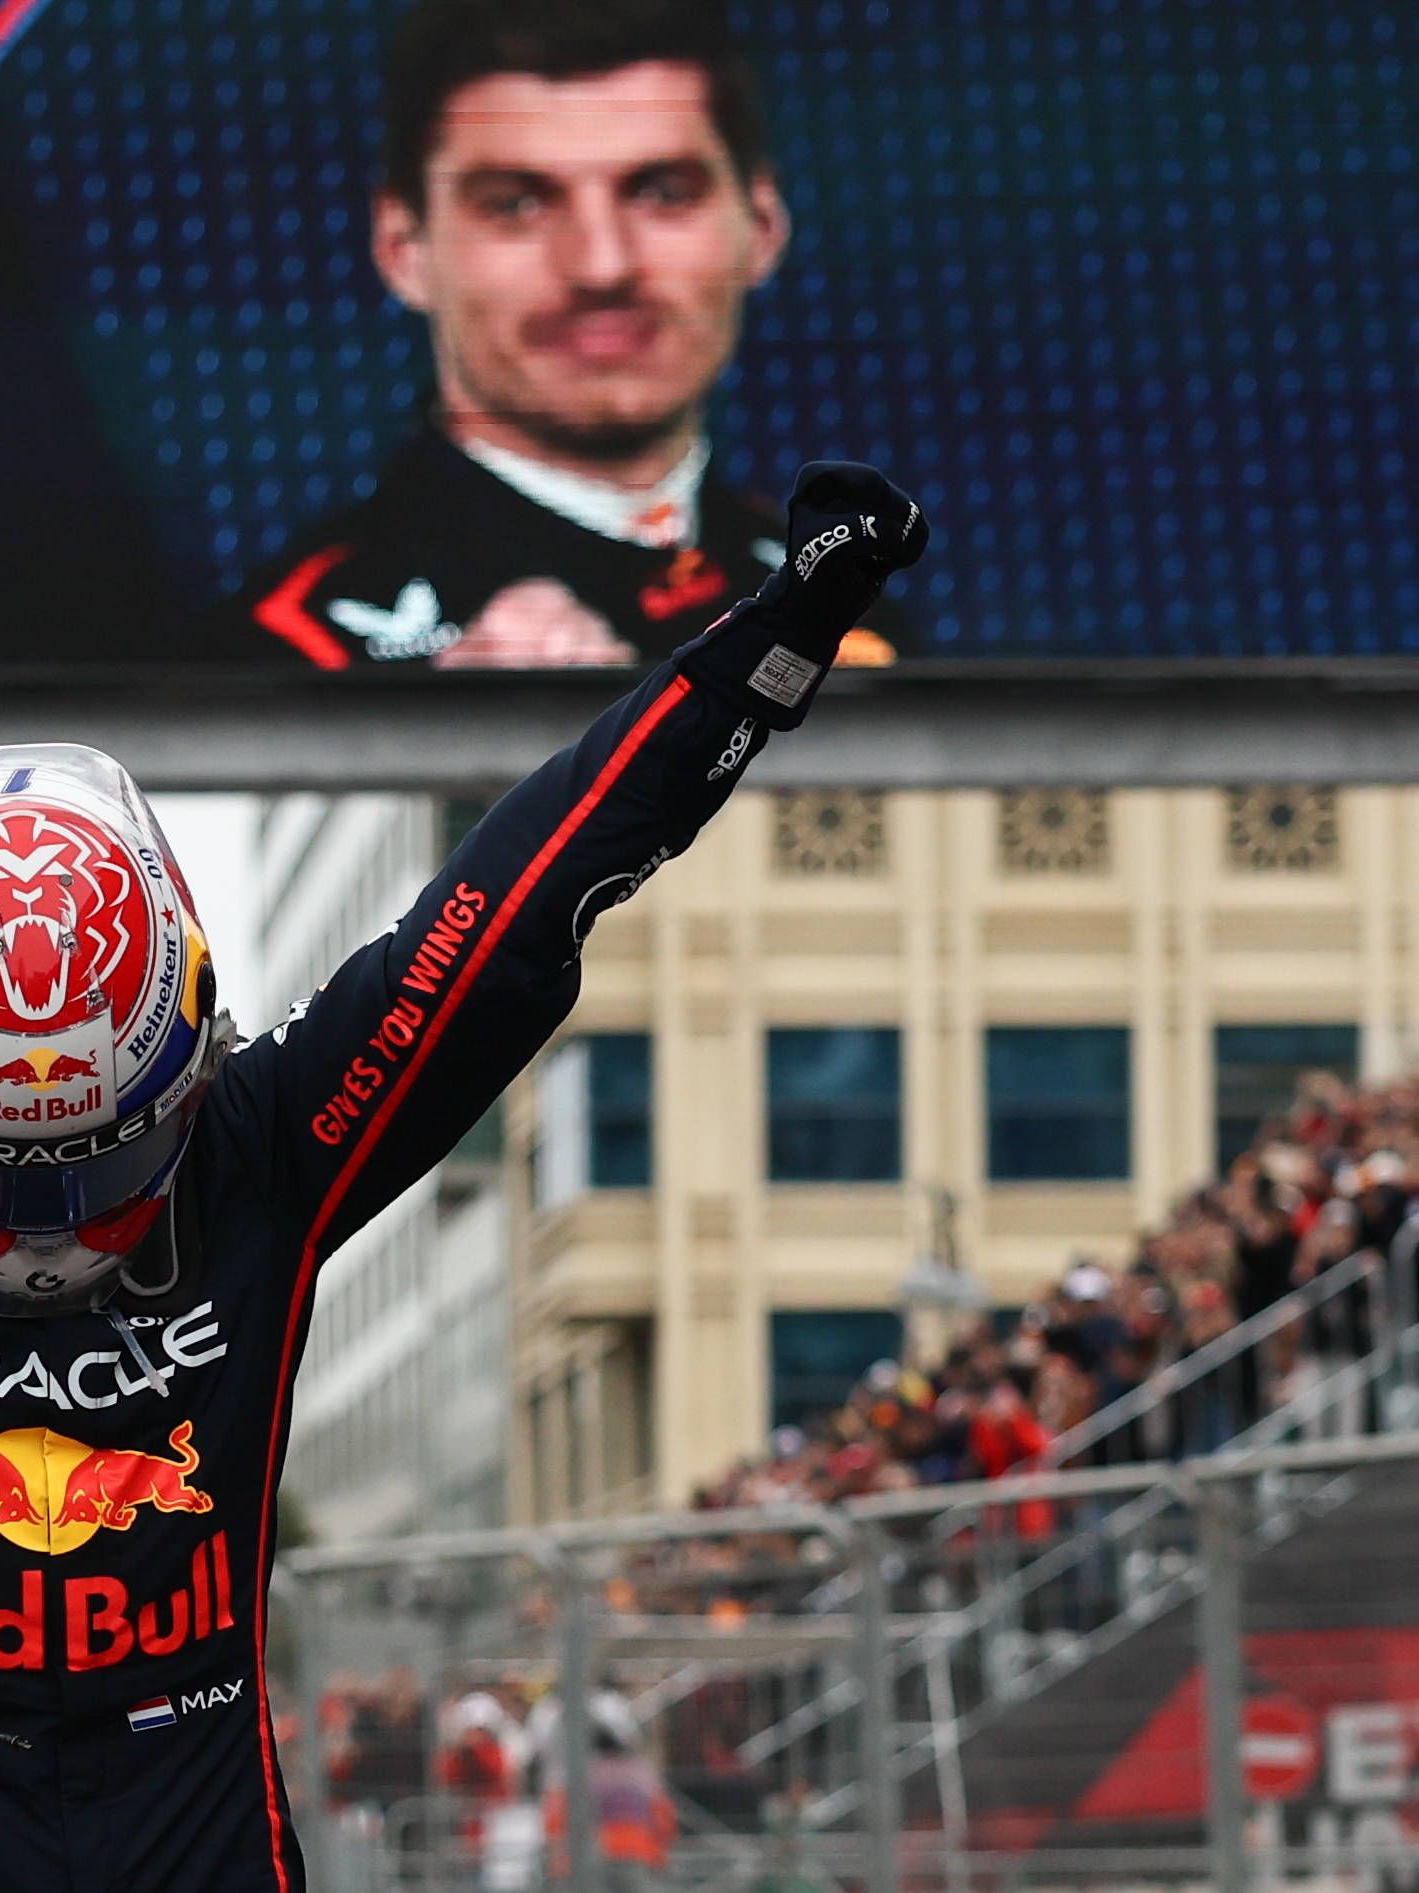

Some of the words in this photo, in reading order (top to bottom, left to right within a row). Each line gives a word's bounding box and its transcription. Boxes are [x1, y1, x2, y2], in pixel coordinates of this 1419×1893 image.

[795, 524, 850, 577] sparco
[707, 717, 755, 782] spar
[127, 938, 177, 1062] Heineken
[311, 1057, 383, 1145] GIVES
[368, 997, 424, 1062] YOU
[402, 882, 485, 994] WINGS
[47, 1085, 101, 1122] Bull
[64, 1529, 234, 1672] Bull
[180, 1678, 244, 1715] MAX
